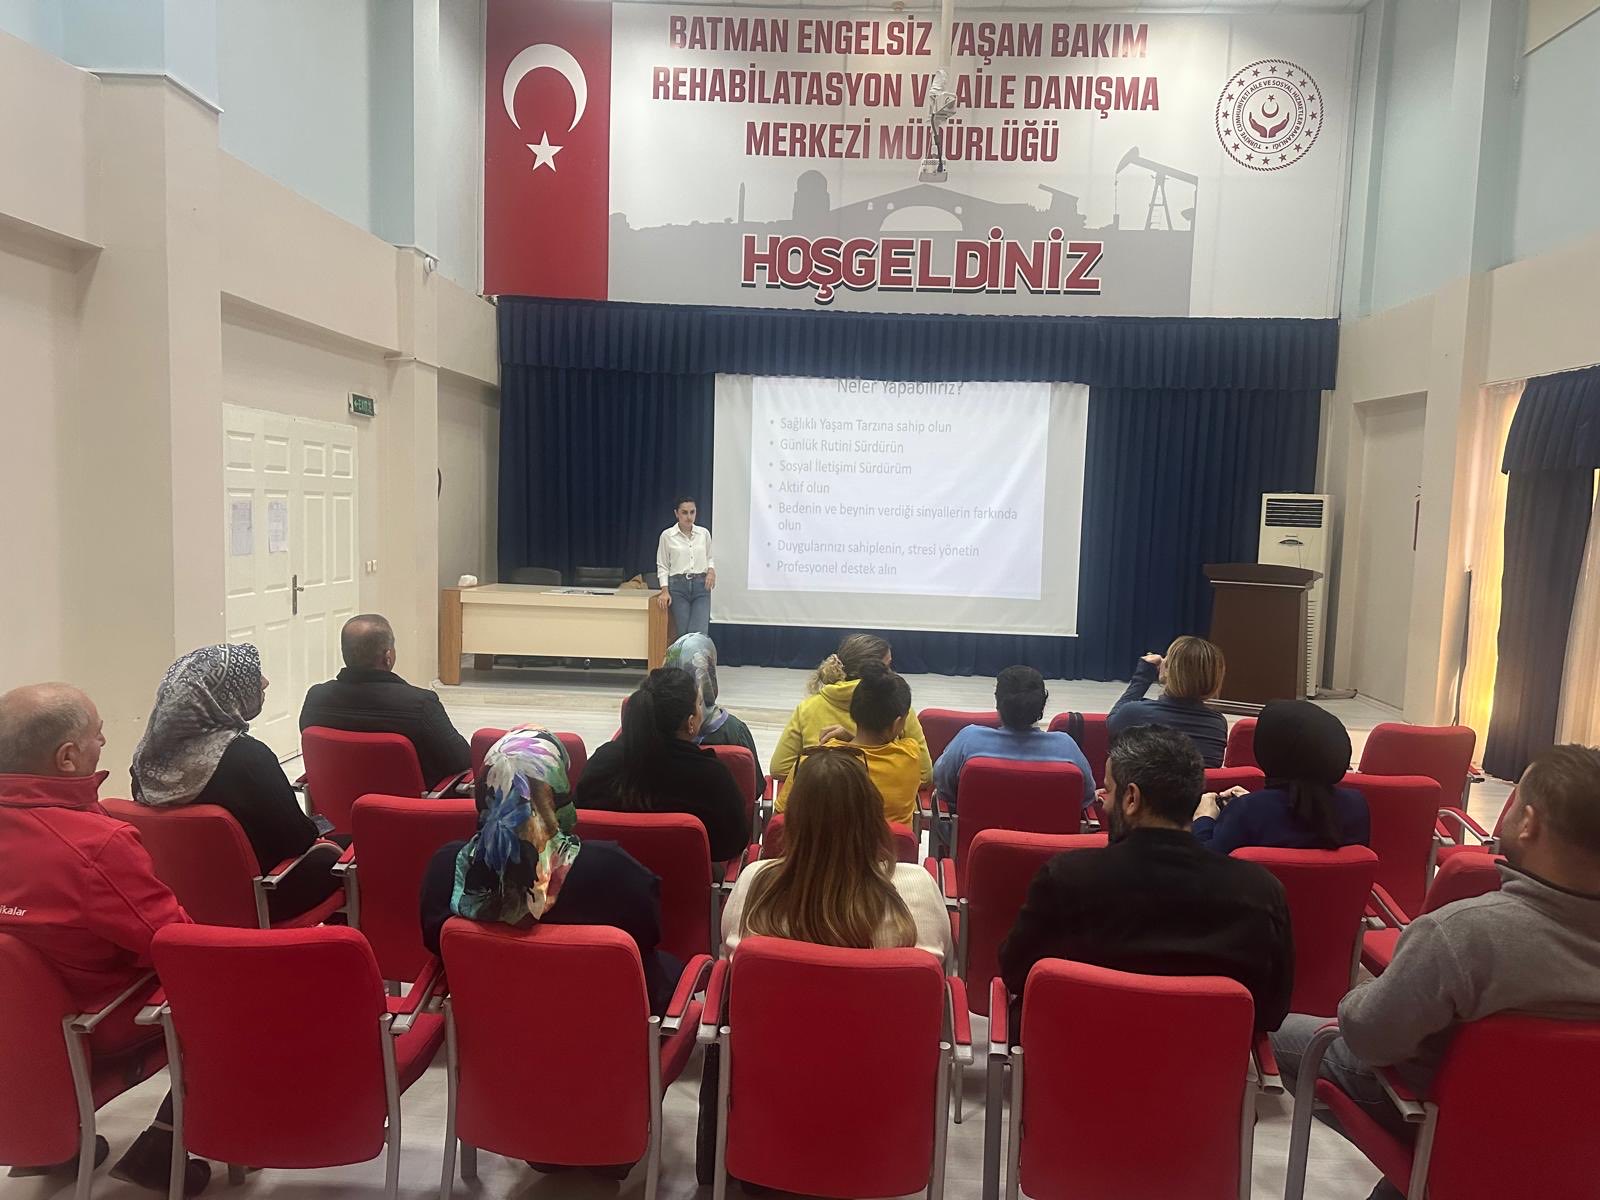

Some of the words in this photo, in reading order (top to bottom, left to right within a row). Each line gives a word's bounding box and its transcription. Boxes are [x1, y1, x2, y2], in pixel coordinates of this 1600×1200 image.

[669, 15, 789, 52] BATMAN
[798, 15, 933, 56] ENGELSİZ
[1051, 23, 1149, 58] BAKIM
[652, 63, 903, 107] REHABİLATASYON
[911, 74, 936, 107] V
[955, 68, 1016, 109] AİLE
[1023, 75, 1160, 119] DANIŞMA
[1250, 81, 1263, 93] AİLE
[1272, 80, 1293, 94] SOSYAL
[1293, 91, 1304, 125] HİZMETLER
[746, 118, 871, 159] MERKEZİ
[1240, 131, 1261, 149] TÜRKİYE
[741, 226, 1104, 304] HOŞGELDİNİZ
[837, 380, 877, 393] Neler
[780, 417, 817, 432] Sağlıklı
[820, 418, 853, 432] Yaşam
[856, 420, 893, 432] Tarzına
[897, 420, 925, 435] sahip
[928, 421, 952, 433] olun
[780, 438, 818, 451] Günlük
[821, 440, 852, 452] Rutini
[854, 440, 904, 454] Sürdürün
[779, 460, 812, 474] Sosyal
[815, 460, 856, 475] İletişimi
[779, 481, 804, 493] Aktif
[807, 482, 830, 494] olun
[779, 502, 821, 515] Bedenin
[825, 505, 837, 515] ve
[840, 503, 875, 518] beynin
[878, 504, 914, 520] verdiği
[916, 505, 970, 520] sinyallerin
[973, 506, 1018, 520] farkında
[778, 519, 801, 531] olun
[777, 540, 845, 554] Duygularınızı
[848, 540, 905, 556] sahiplenin,
[908, 543, 936, 556] stresi
[939, 544, 979, 558] yönetin
[777, 560, 838, 574] Profesyonel
[841, 562, 875, 575] destek
[878, 563, 897, 575] alın
